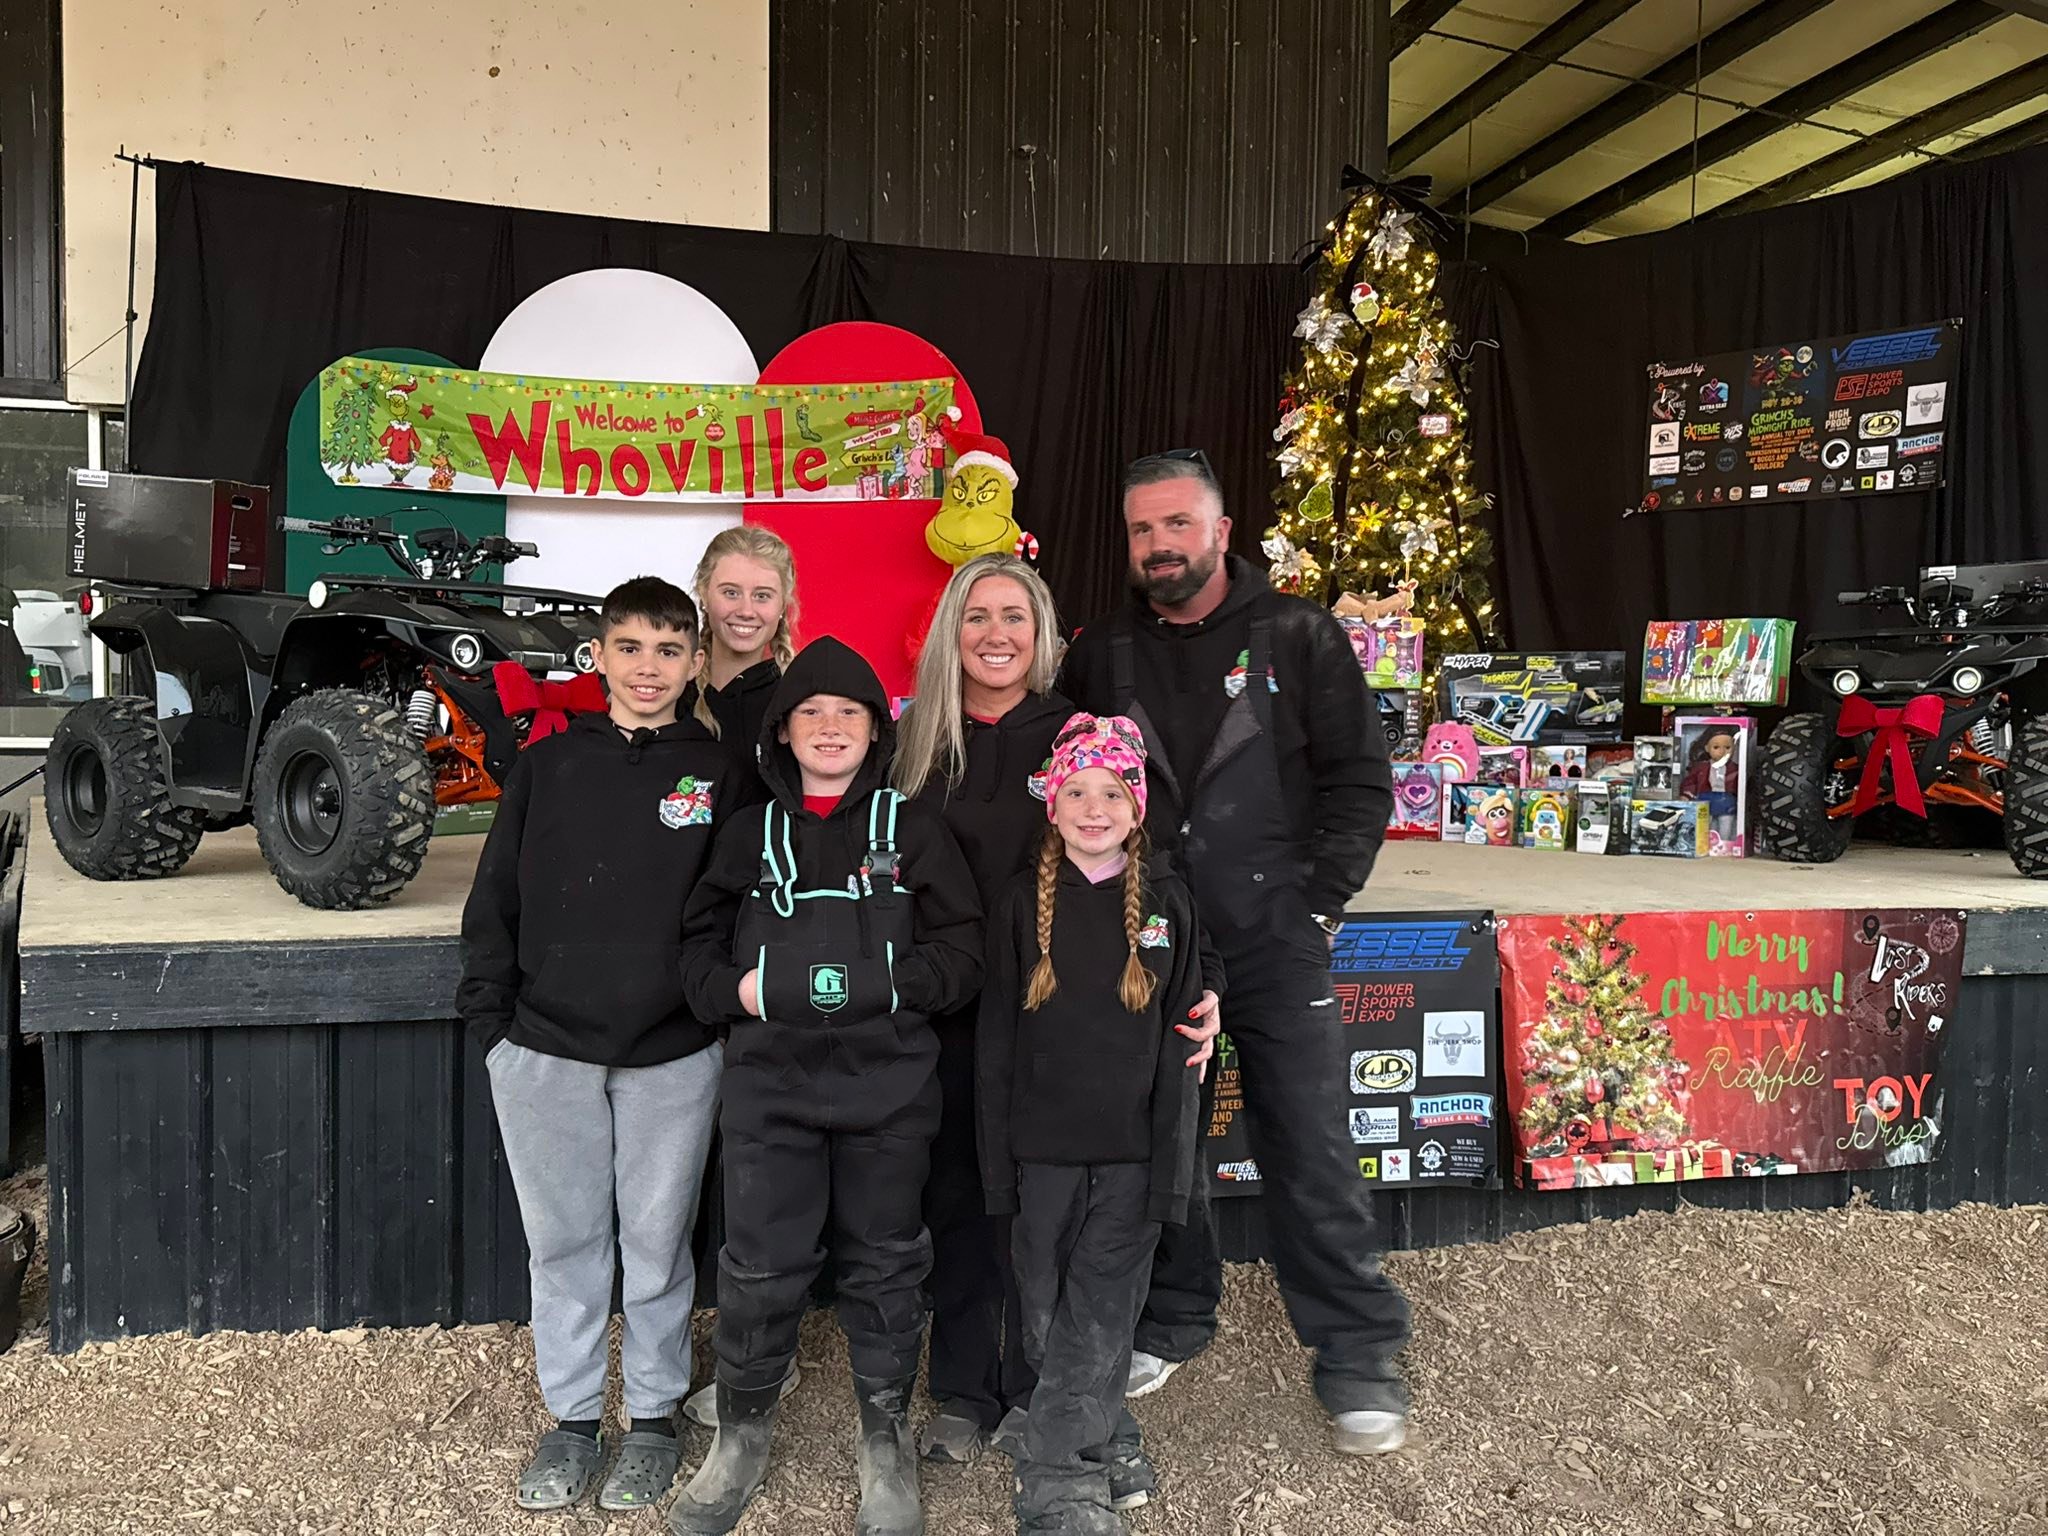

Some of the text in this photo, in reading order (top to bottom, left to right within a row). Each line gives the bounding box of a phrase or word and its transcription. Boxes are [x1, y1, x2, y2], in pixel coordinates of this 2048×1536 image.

[1655, 363, 1693, 378] Powered
[1870, 370, 1903, 380] POWER
[1868, 378, 1903, 389] SPORTS
[1865, 387, 1890, 397] EXPO
[574, 402, 685, 435] Welcome to
[1828, 408, 1849, 420] HIGH
[1747, 417, 1812, 437] MIDNIGHT RIDE
[1825, 416, 1852, 430] PROOF
[1683, 422, 1720, 441] EXTREME
[1902, 435, 1940, 448] ANCHOR
[466, 400, 829, 498] Whoville
[73, 498, 86, 573] HELMET
[1453, 656, 1488, 668] HYPER
[1706, 920, 1815, 973] Merry
[1364, 984, 1414, 996] POWER
[1661, 971, 1844, 1021] Christmas!
[1360, 996, 1415, 1009] SPORTS
[1358, 1009, 1395, 1022] EXPO
[1711, 1018, 1808, 1064] ATV
[1690, 1042, 1825, 1103] Raffle
[1834, 1073, 1933, 1124] TOY
[1420, 1099, 1484, 1113] ANCHOR
[1211, 1112, 1233, 1123] AND
[1424, 1115, 1455, 1124] HEATING
[1465, 1113, 1479, 1121] AIR
